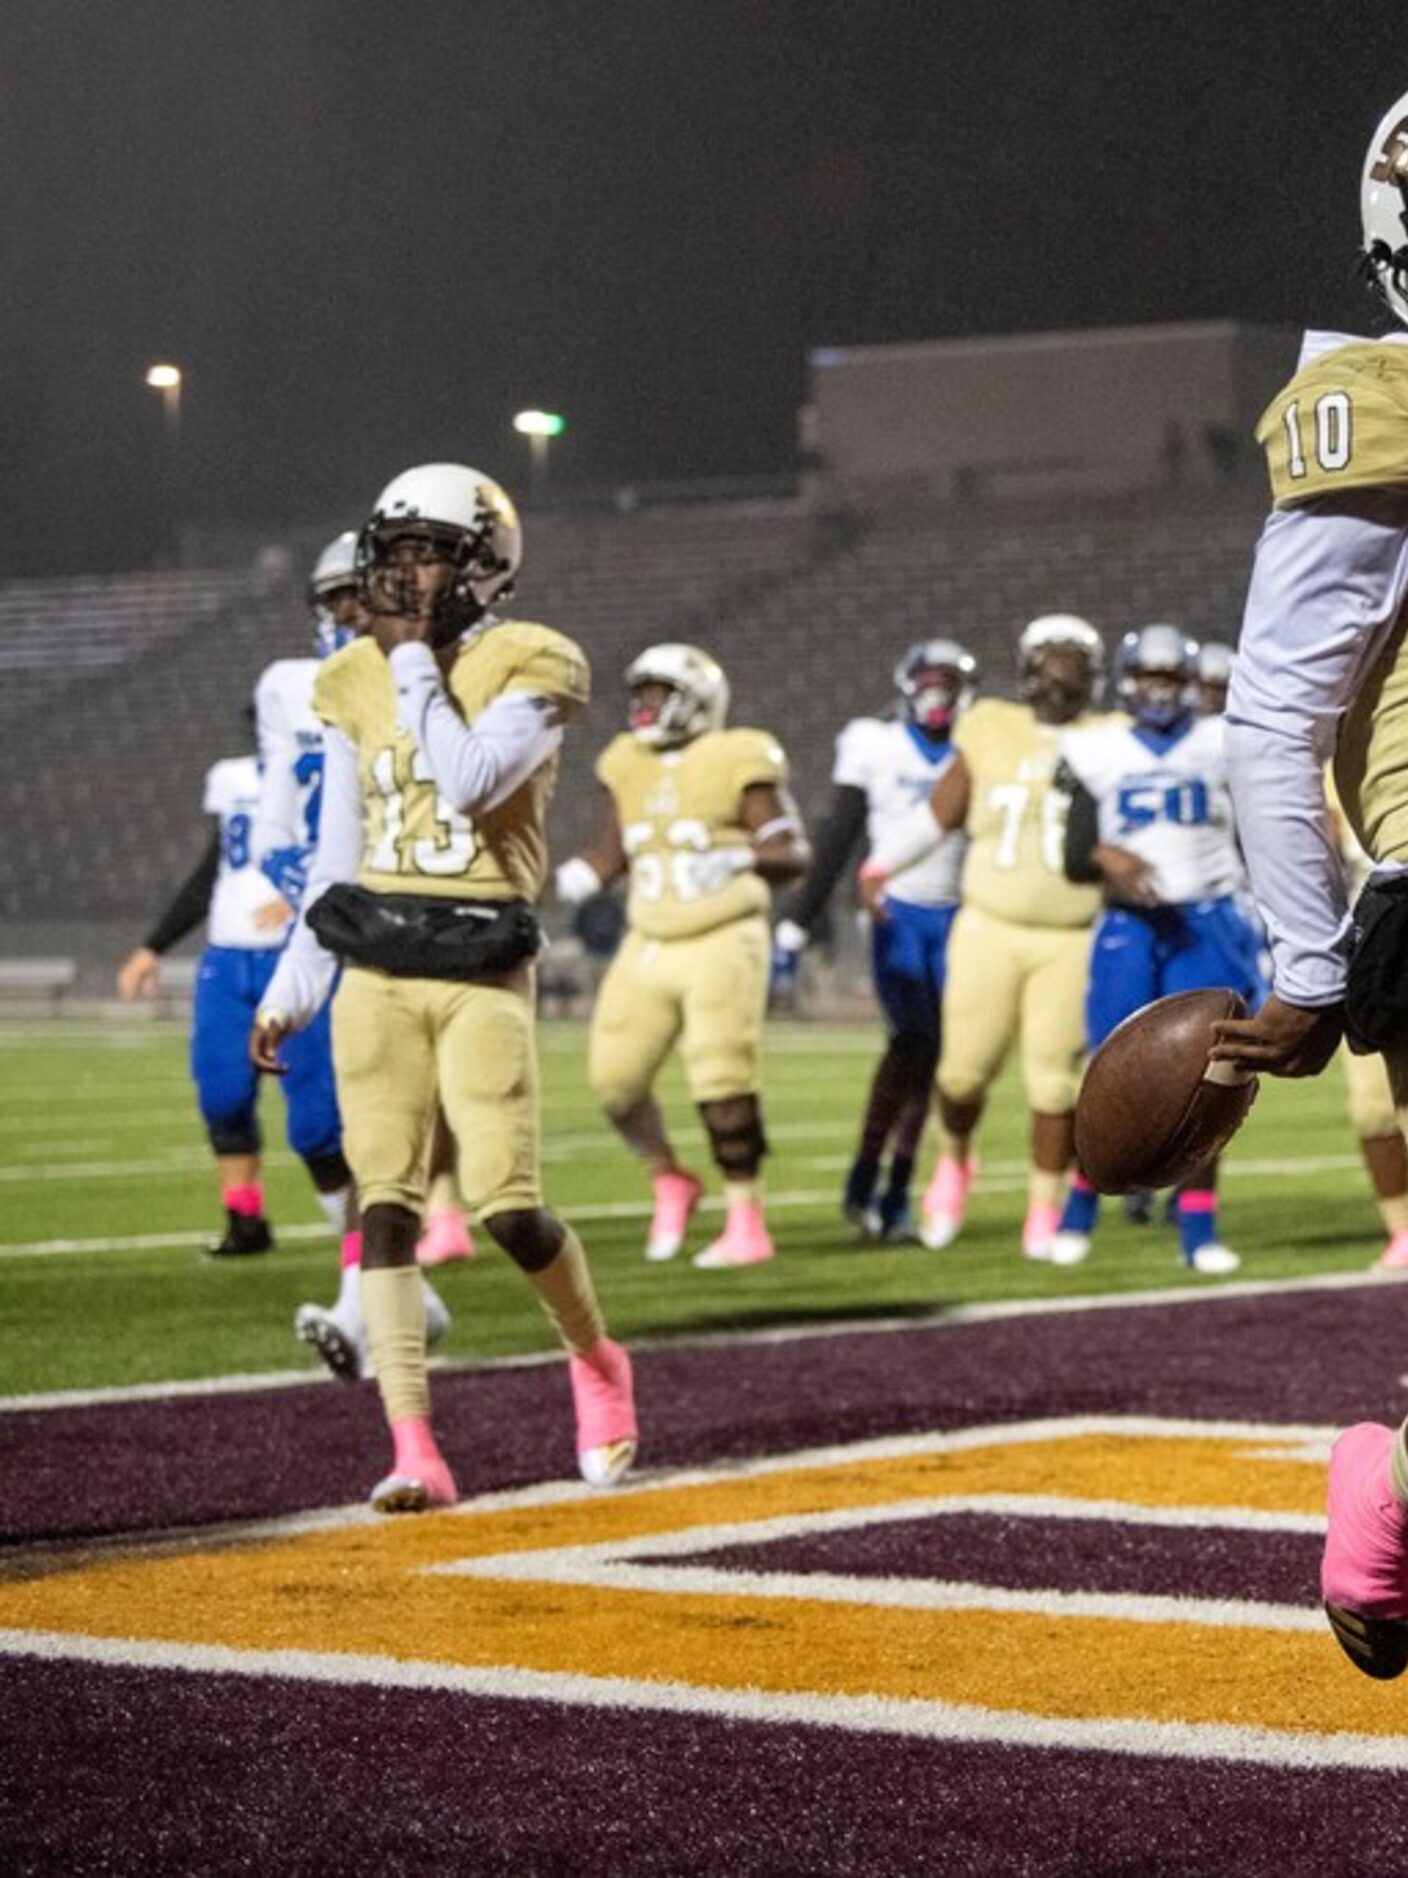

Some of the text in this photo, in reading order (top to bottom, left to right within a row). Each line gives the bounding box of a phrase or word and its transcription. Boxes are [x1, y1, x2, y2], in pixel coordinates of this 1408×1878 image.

[1282, 391, 1353, 478] 10
[364, 746, 480, 877] 13
[1115, 774, 1210, 834] 50
